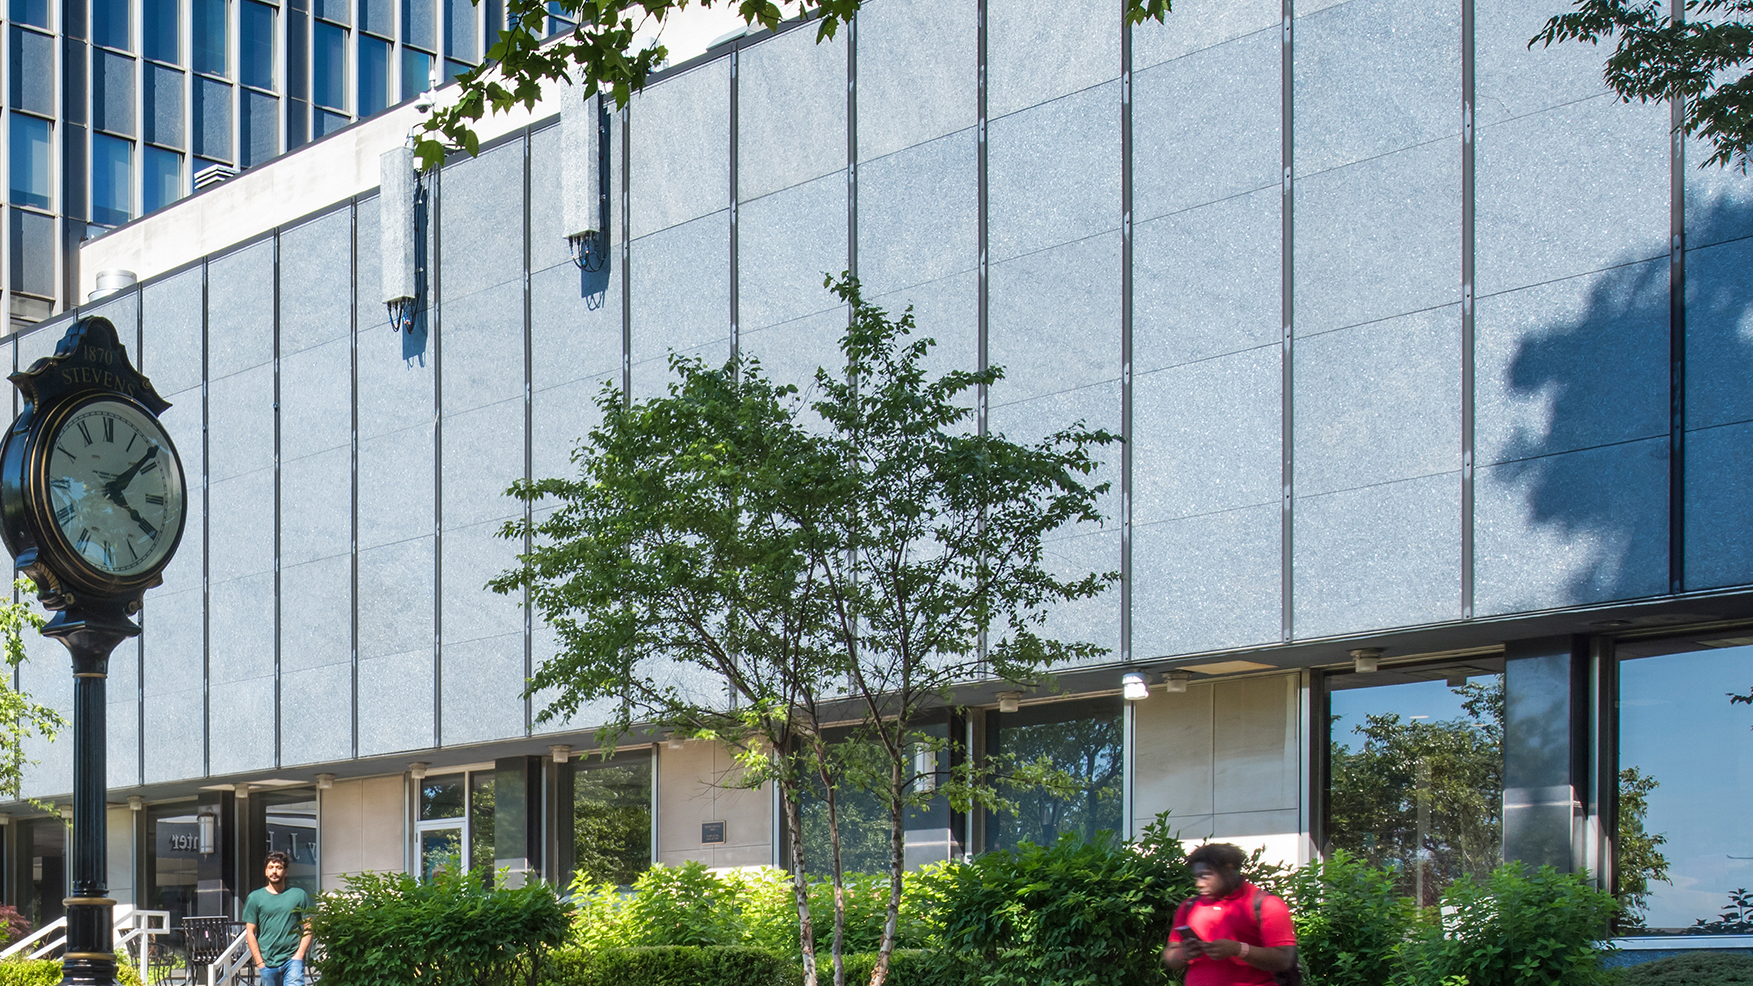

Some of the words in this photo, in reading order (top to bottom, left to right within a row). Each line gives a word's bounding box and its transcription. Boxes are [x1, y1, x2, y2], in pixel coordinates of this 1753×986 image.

[83, 344, 113, 365] 1870
[61, 366, 136, 398] STEVENS
[77, 419, 93, 448] XI
[103, 416, 114, 443] XII
[56, 441, 77, 464] X
[126, 432, 138, 453] I
[139, 461, 157, 475] II
[145, 493, 164, 506] III
[126, 537, 138, 562] V
